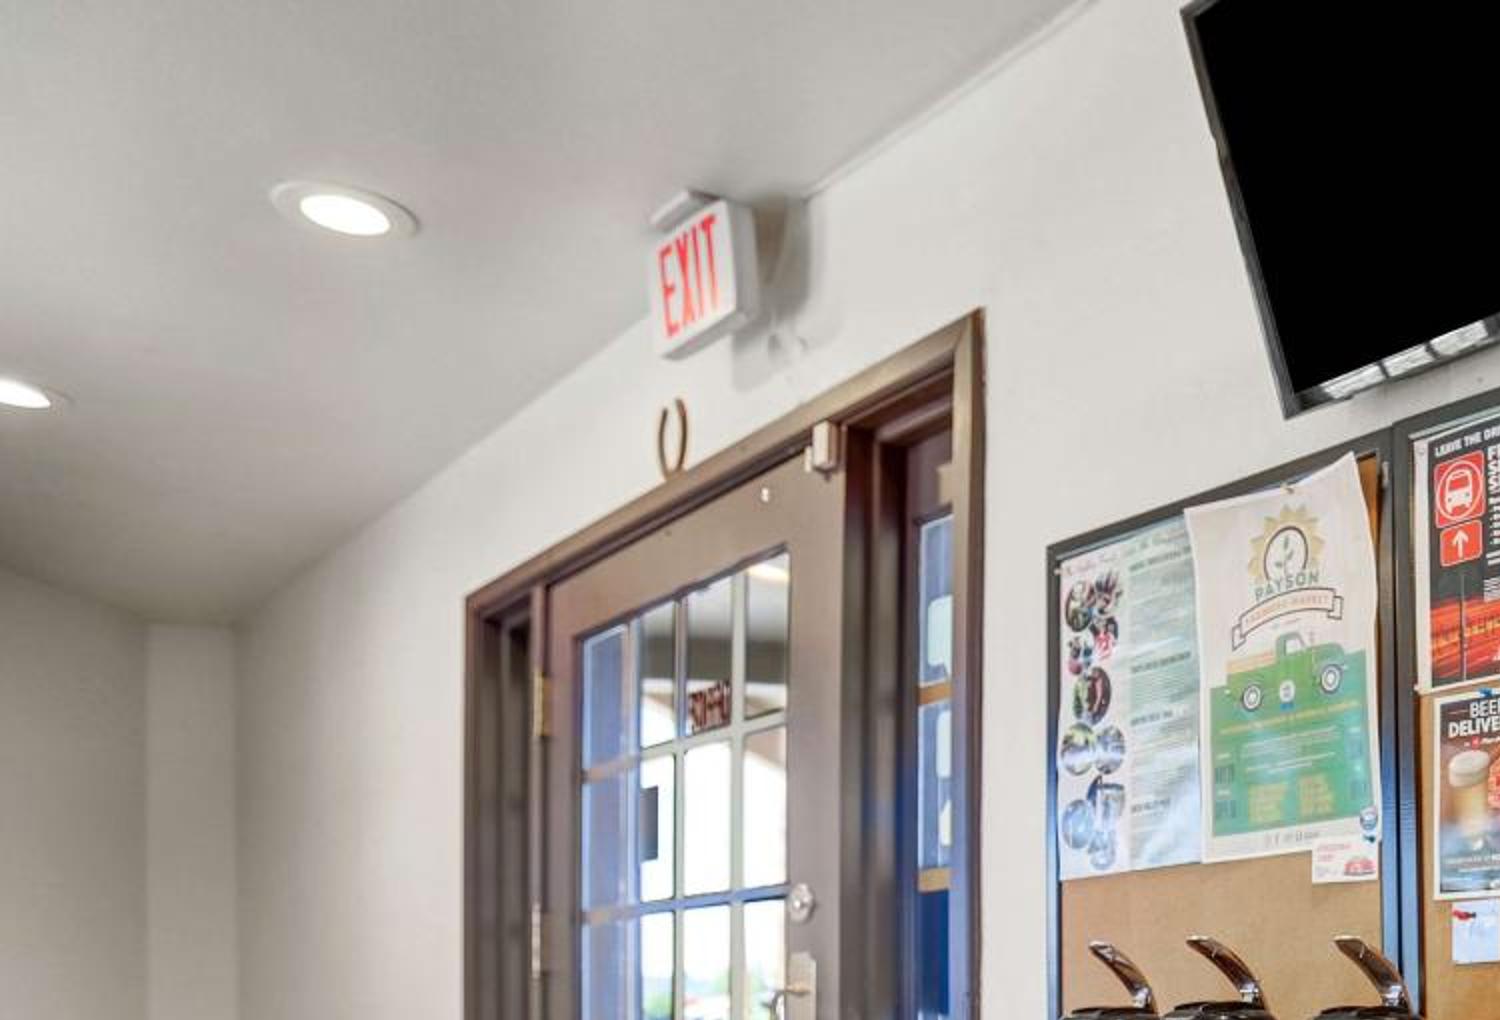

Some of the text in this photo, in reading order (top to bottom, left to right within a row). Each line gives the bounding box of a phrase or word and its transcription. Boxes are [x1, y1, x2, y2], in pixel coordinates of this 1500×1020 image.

[658, 213, 718, 338] EXIT
[1463, 431, 1482, 447] THE
[1255, 570, 1320, 600] PAYSON
